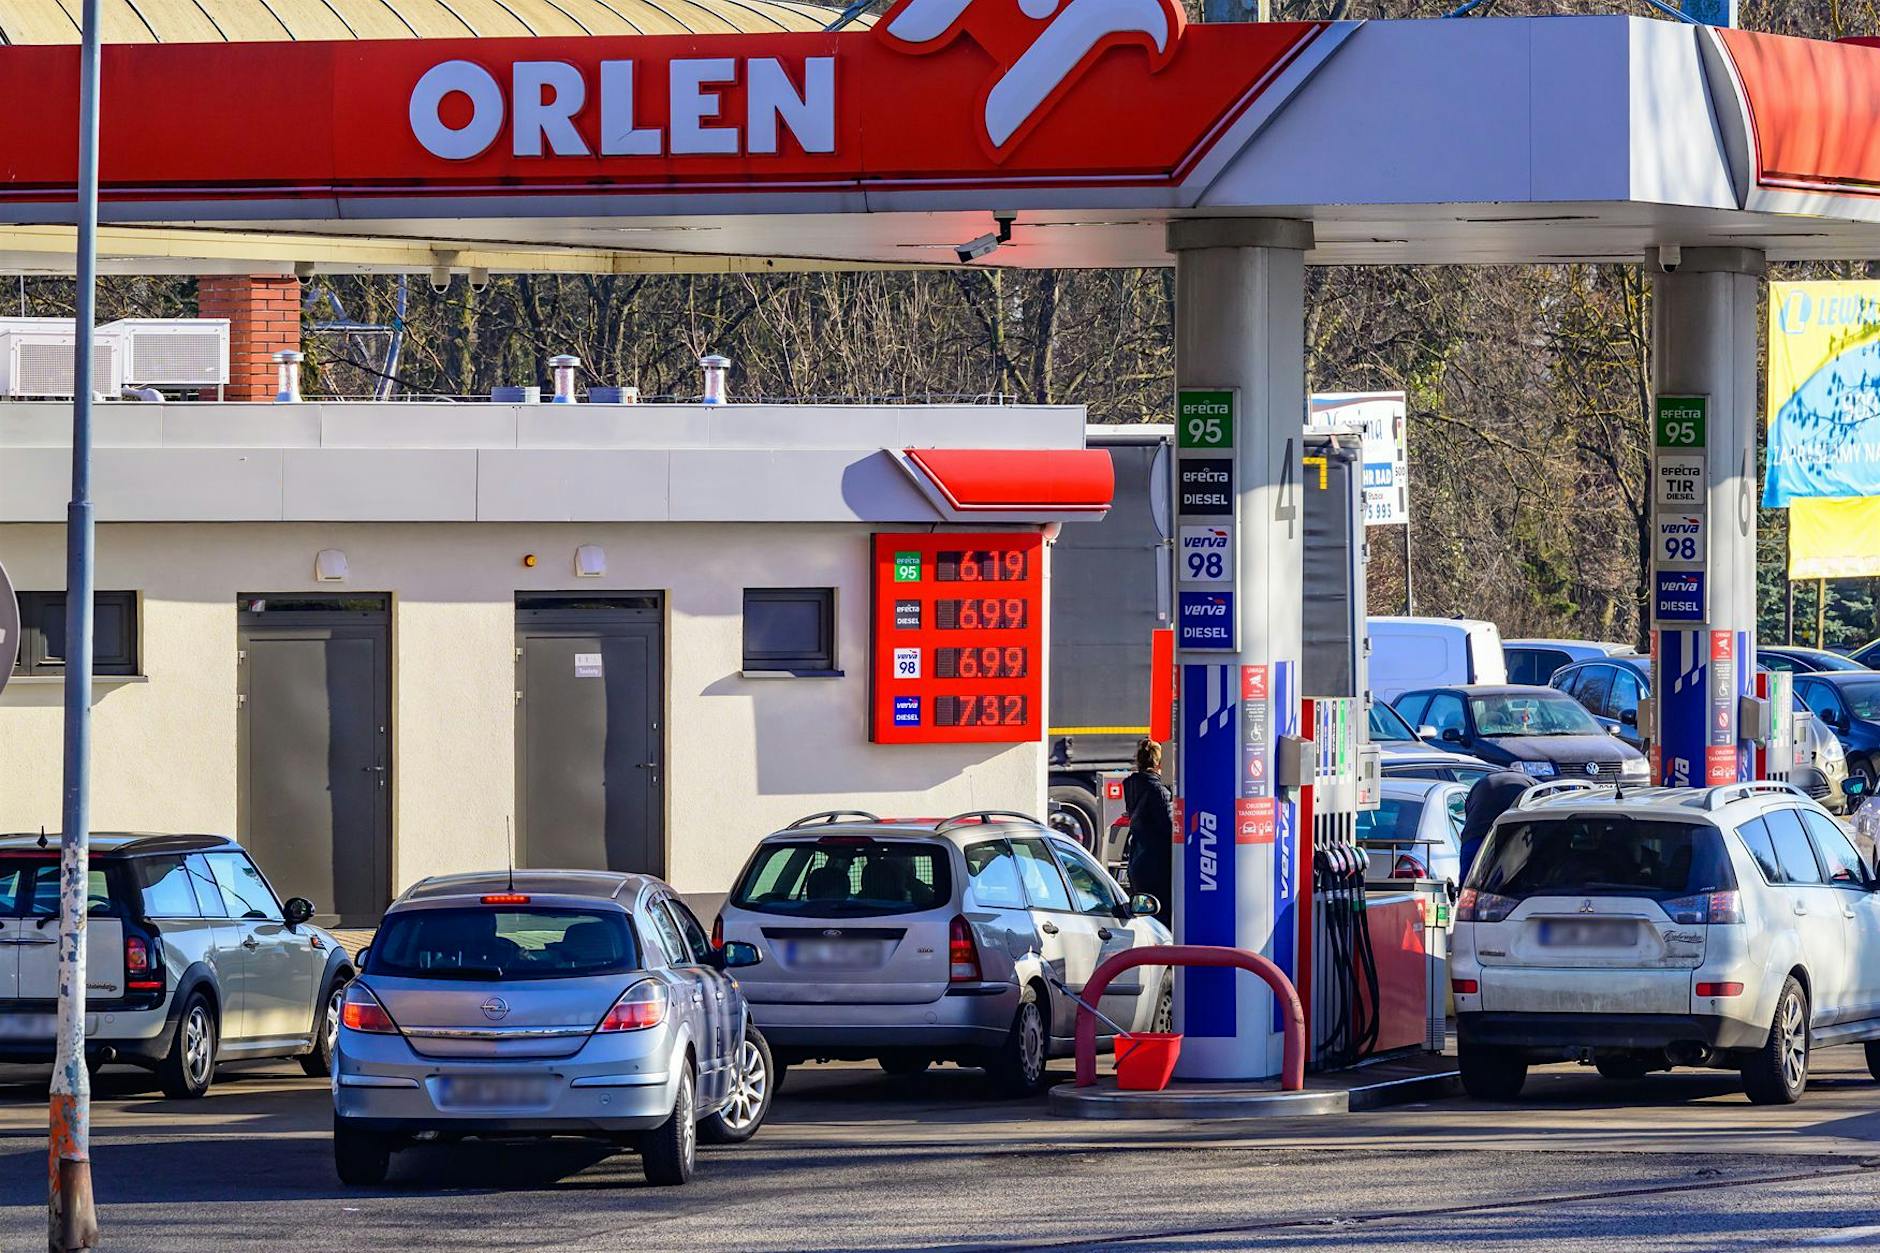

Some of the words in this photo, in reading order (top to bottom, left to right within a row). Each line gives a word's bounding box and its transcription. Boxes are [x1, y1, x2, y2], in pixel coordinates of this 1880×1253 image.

[410, 56, 834, 160] ORLEN
[1188, 419, 1222, 443] 95
[1665, 422, 1696, 444] 95
[1375, 468, 1392, 486] BAD
[1274, 438, 1296, 539] 4
[1666, 480, 1694, 492] TIR
[1183, 494, 1228, 505] DIESEL
[1376, 503, 1391, 519] 993
[1661, 524, 1700, 534] verva
[1184, 537, 1228, 548] verva
[1665, 537, 1696, 560] 98
[899, 566, 917, 579] 95
[959, 551, 1024, 581] 6.19
[1187, 552, 1223, 578] 98
[1661, 581, 1698, 592] verva
[959, 599, 1024, 629] 6.99
[1184, 604, 1227, 616] verva
[1660, 601, 1699, 611] DIESEL
[1183, 627, 1228, 638] DIESEL
[897, 652, 918, 660] verva
[959, 647, 1024, 678] 6.99
[899, 661, 916, 674] 98
[896, 702, 919, 710] verva
[959, 695, 1022, 726] 7.32
[1199, 811, 1217, 891] verva
